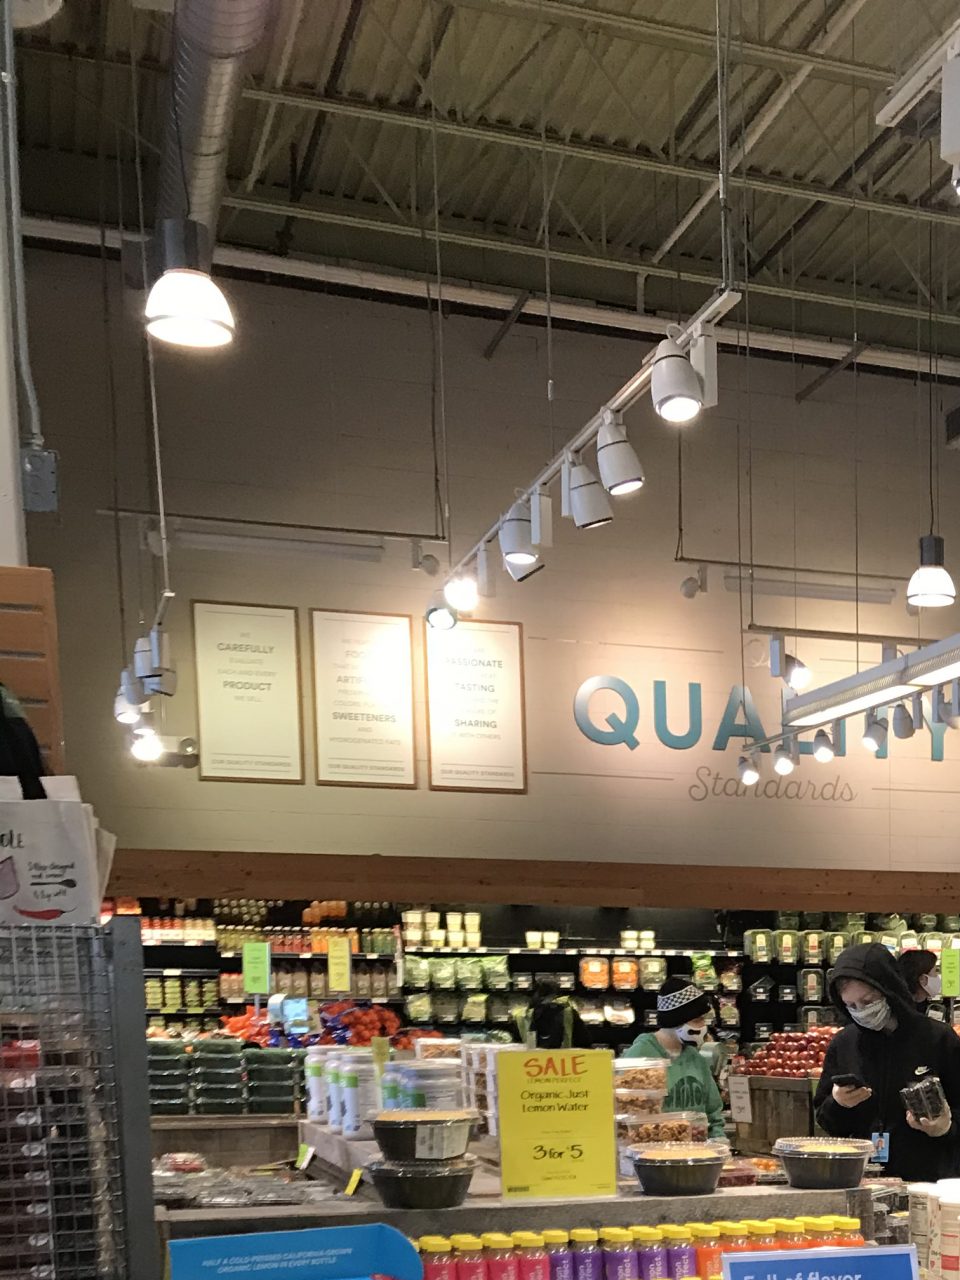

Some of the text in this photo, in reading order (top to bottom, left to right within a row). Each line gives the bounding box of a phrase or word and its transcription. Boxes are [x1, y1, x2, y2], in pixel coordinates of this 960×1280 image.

[217, 642, 275, 655] CAREFULLY
[223, 681, 272, 692] PRODUCT
[331, 712, 397, 723] SWEETENERS
[573, 674, 949, 763] QUALY
[454, 719, 498, 730] SHARING
[689, 766, 857, 803] Standards
[523, 1054, 588, 1078] SALE
[520, 1089, 588, 1102] Organic Just
[522, 1102, 589, 1113] Lemon Water
[533, 1145, 547, 1160] 3
[548, 1148, 565, 1159] for
